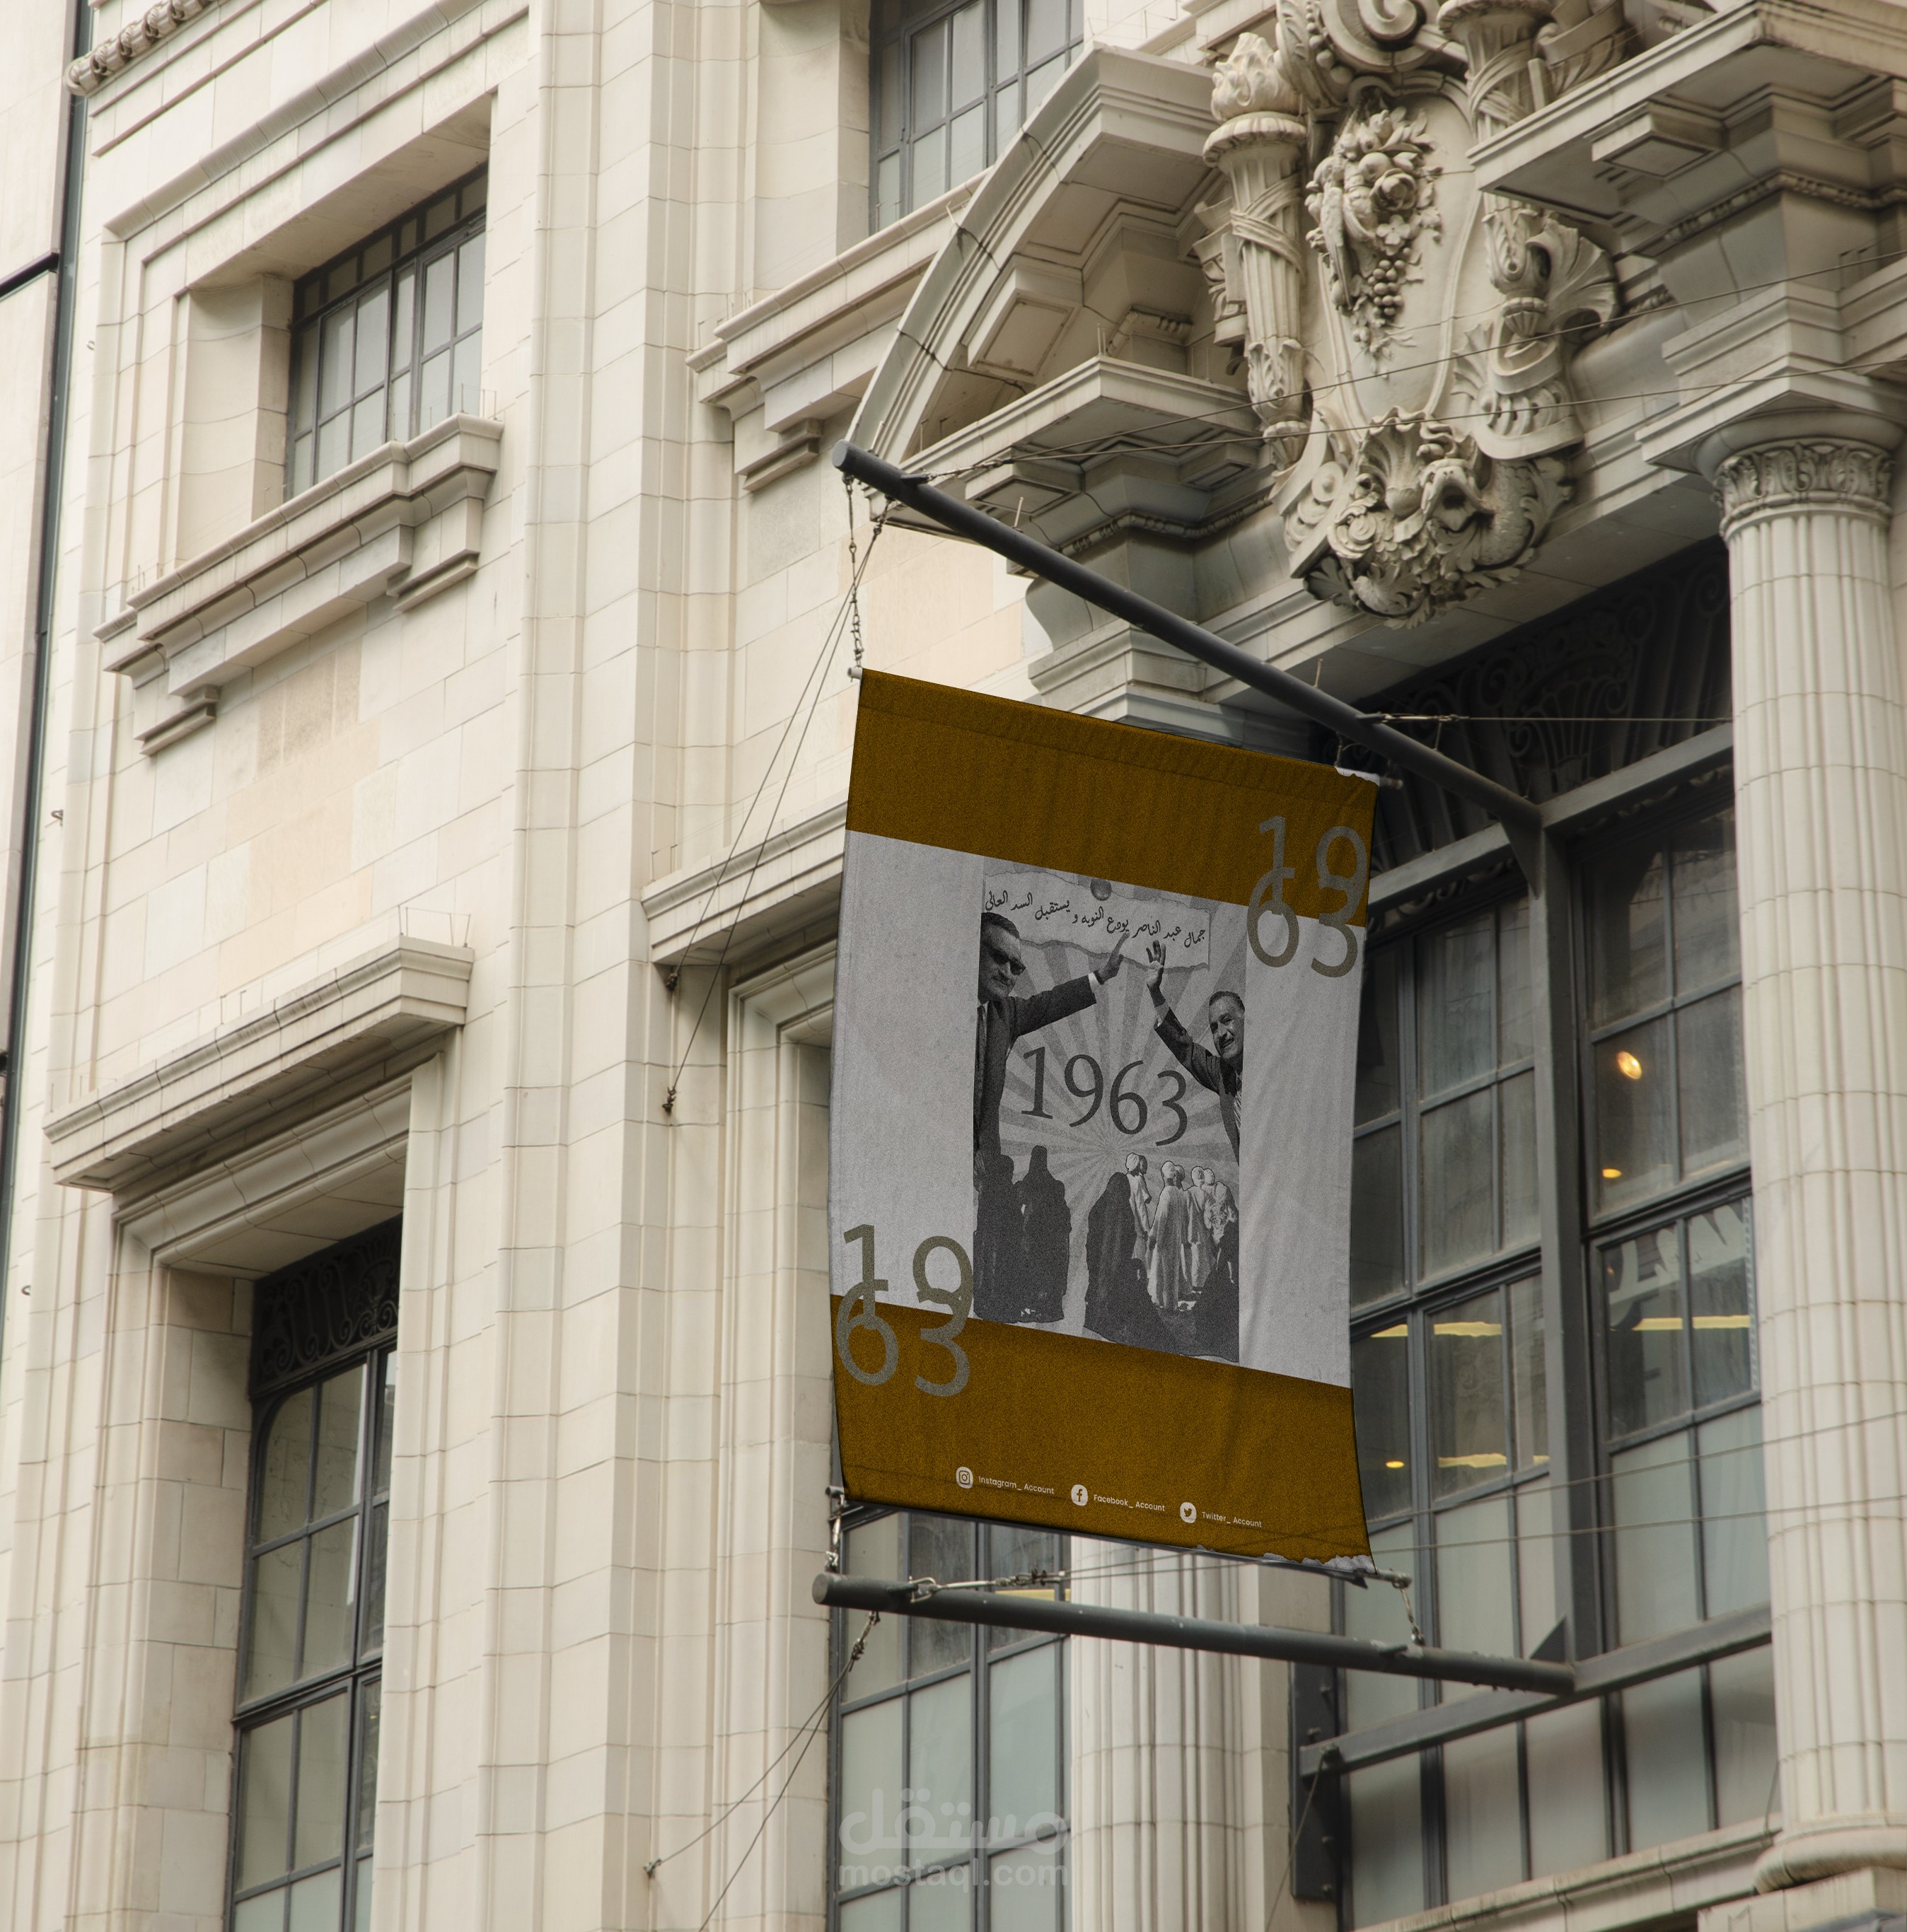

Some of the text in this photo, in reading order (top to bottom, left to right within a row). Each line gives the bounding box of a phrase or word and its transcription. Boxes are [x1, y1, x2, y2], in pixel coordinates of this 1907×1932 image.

[1010, 892, 1033, 911] السد
[1034, 900, 1070, 921] يستقبل
[1072, 914, 1078, 924] و
[1106, 916, 1129, 933] يودع
[1131, 920, 1161, 938] الناصر
[1162, 925, 1182, 939] عبد
[1183, 929, 1207, 948] جمال
[1021, 1046, 1188, 1146] 1963
[978, 1475, 1055, 1495] Instagram_ Account
[1094, 1494, 1166, 1512] Facebook_ Account
[1202, 1511, 1263, 1527] Twitter_ Account
